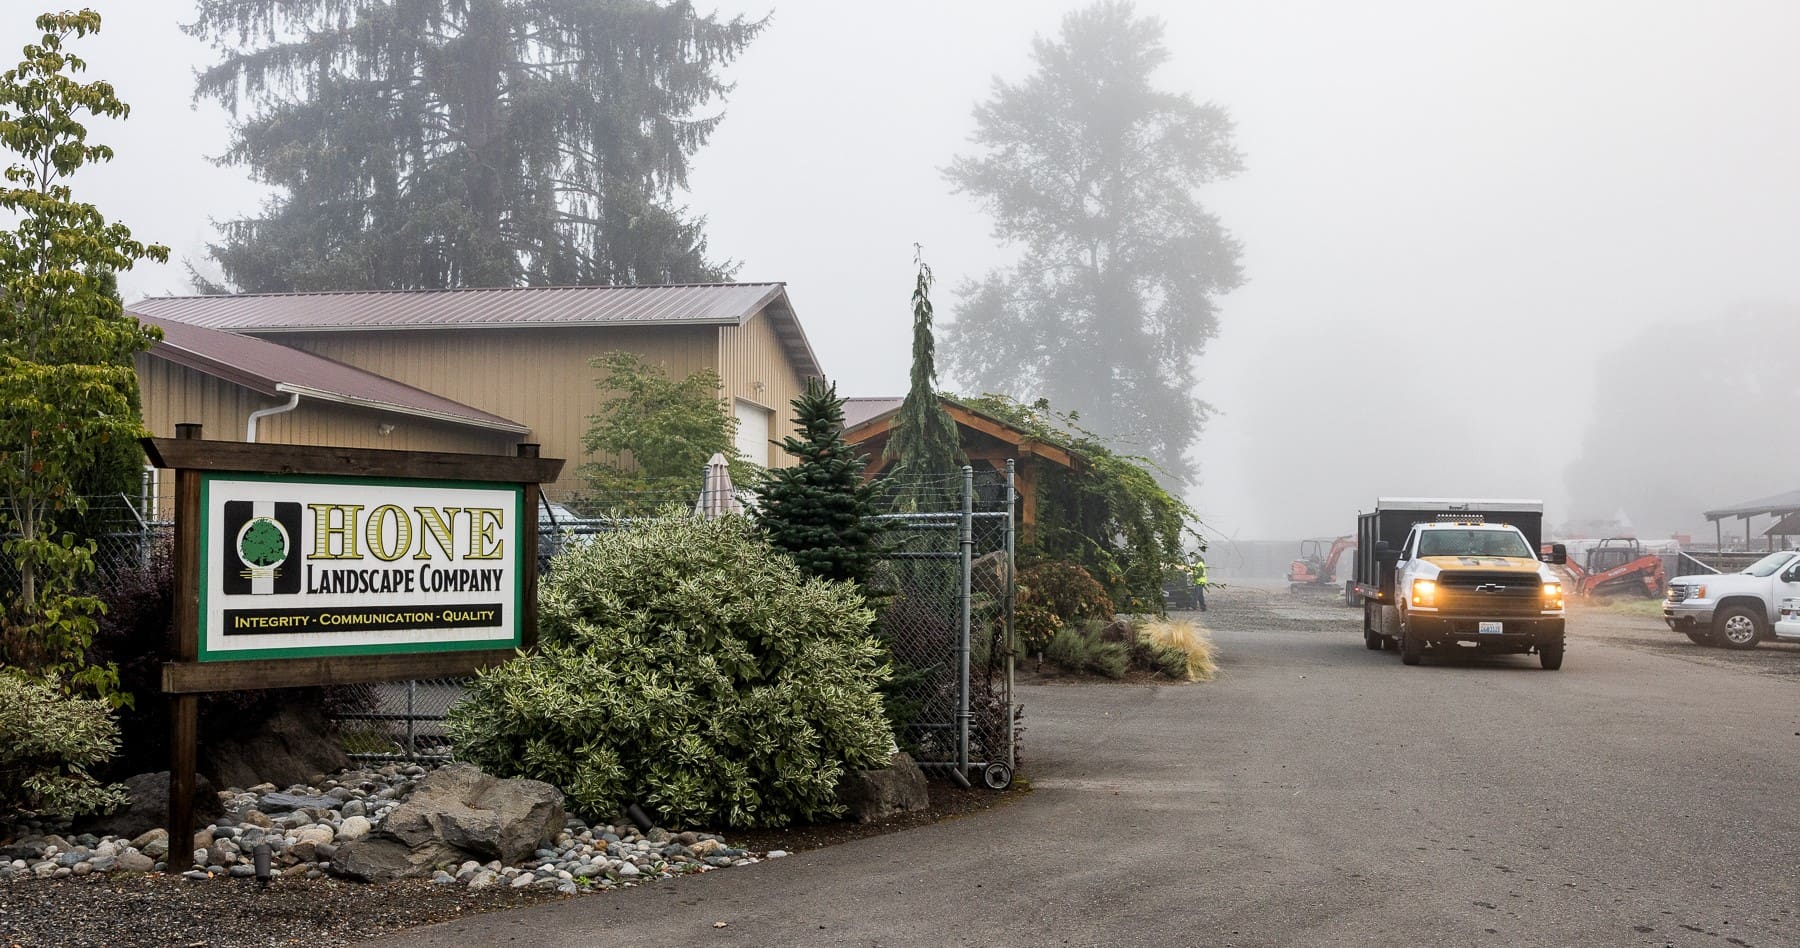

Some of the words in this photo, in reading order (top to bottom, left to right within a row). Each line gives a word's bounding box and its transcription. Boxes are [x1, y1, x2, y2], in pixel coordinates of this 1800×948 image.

[307, 504, 504, 561] HONE
[306, 564, 415, 594] LANDSCAPE
[419, 564, 504, 593] COMPANY
[234, 616, 310, 629] INTEGRITY
[319, 612, 434, 626] COMMUNICATION
[442, 610, 495, 623] QUALITY
